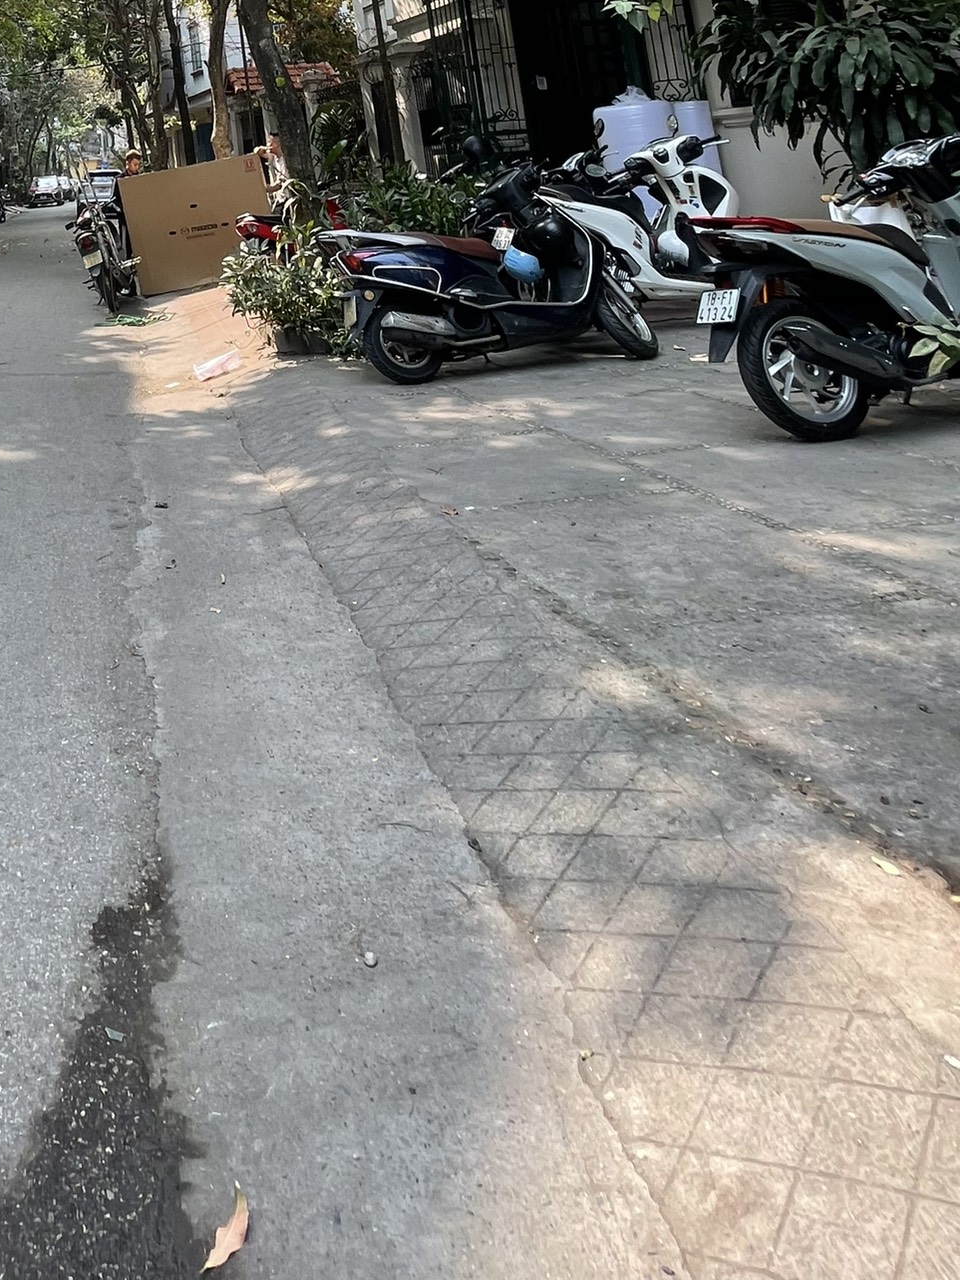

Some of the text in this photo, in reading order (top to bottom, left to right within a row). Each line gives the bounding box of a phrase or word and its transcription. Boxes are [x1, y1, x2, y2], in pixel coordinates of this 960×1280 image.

[793, 236, 846, 248] VISION
[707, 291, 733, 306] 18-F1
[699, 306, 733, 321] 413.24
